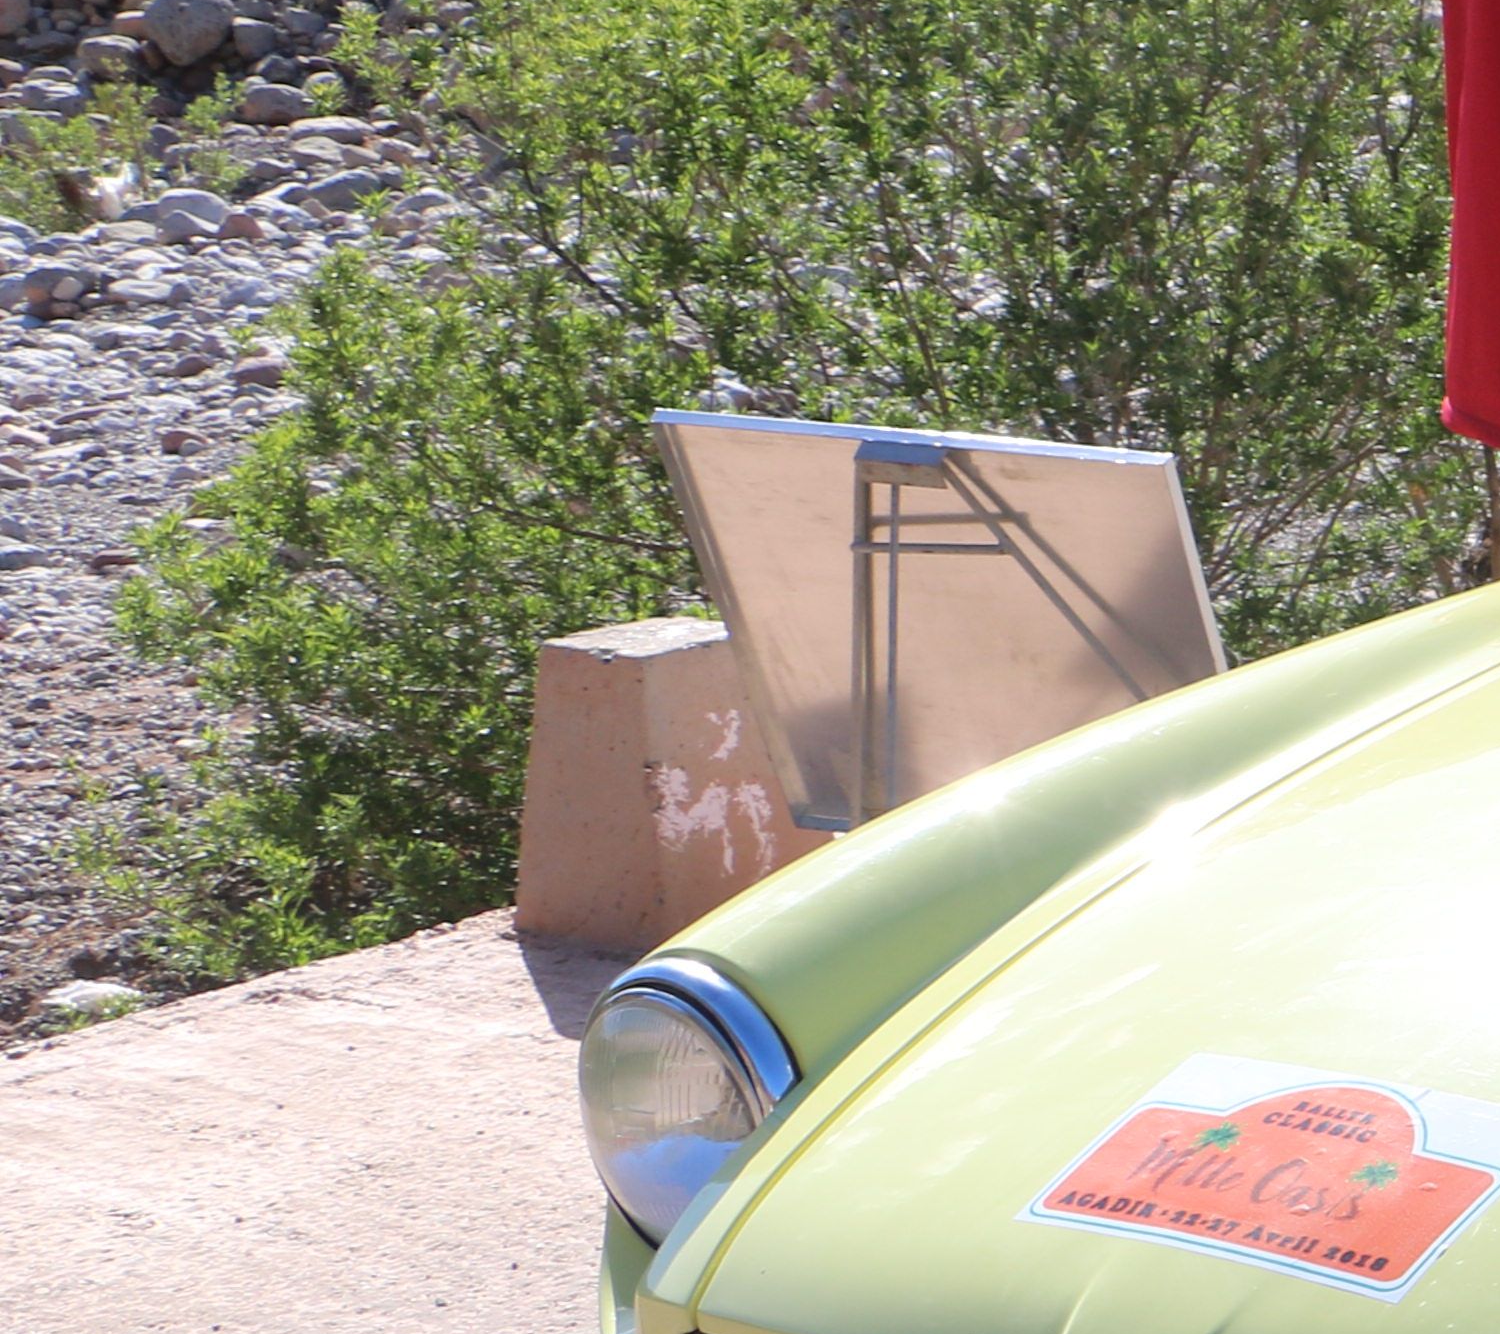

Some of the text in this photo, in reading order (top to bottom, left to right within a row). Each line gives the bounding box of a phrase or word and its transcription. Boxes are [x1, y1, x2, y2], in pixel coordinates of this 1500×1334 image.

[1262, 1111, 1378, 1143] CLASSIC
[1242, 1224, 1320, 1254] Avril
[1321, 1245, 1390, 1272] 2018
